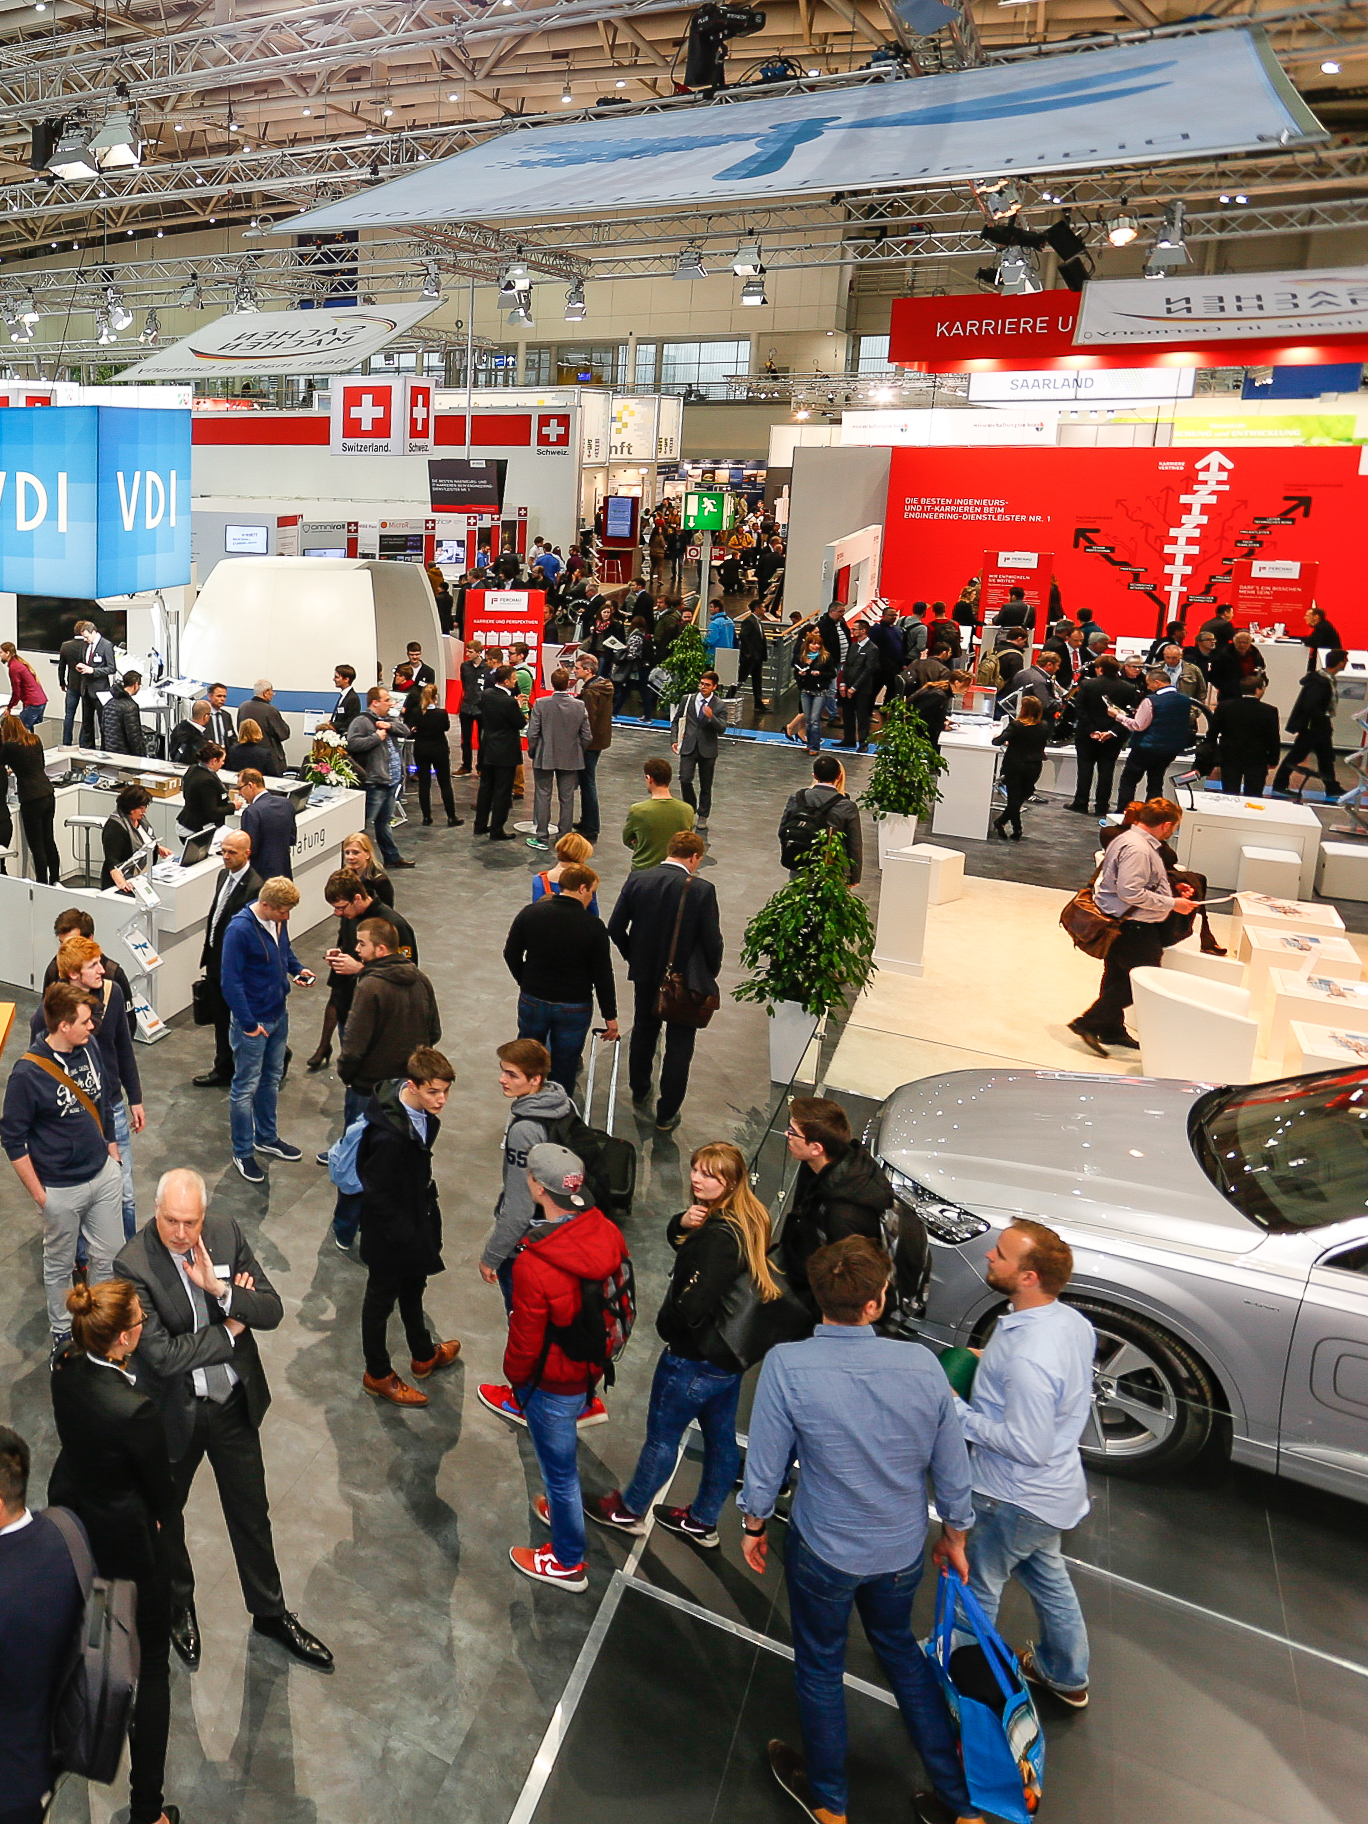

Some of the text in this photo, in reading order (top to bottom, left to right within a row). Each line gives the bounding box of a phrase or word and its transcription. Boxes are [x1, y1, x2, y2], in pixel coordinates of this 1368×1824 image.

[936, 317, 1048, 338] KARRIERE
[1009, 377, 1095, 391] SAARLAND
[341, 442, 392, 453] Switzerland.
[408, 442, 430, 453] Schweiz.
[536, 448, 570, 456] Schweiz.
[116, 469, 177, 532] VDI
[920, 497, 953, 505] BESTEN
[954, 498, 1009, 506] INGENIEURS-
[904, 504, 1005, 514] UND IT-KARRIEREN BEIM
[903, 512, 1027, 522] ENGINEERING-DIENSTLEISTER
[1029, 514, 1044, 523] NR.
[507, 1147, 528, 1168] 55
